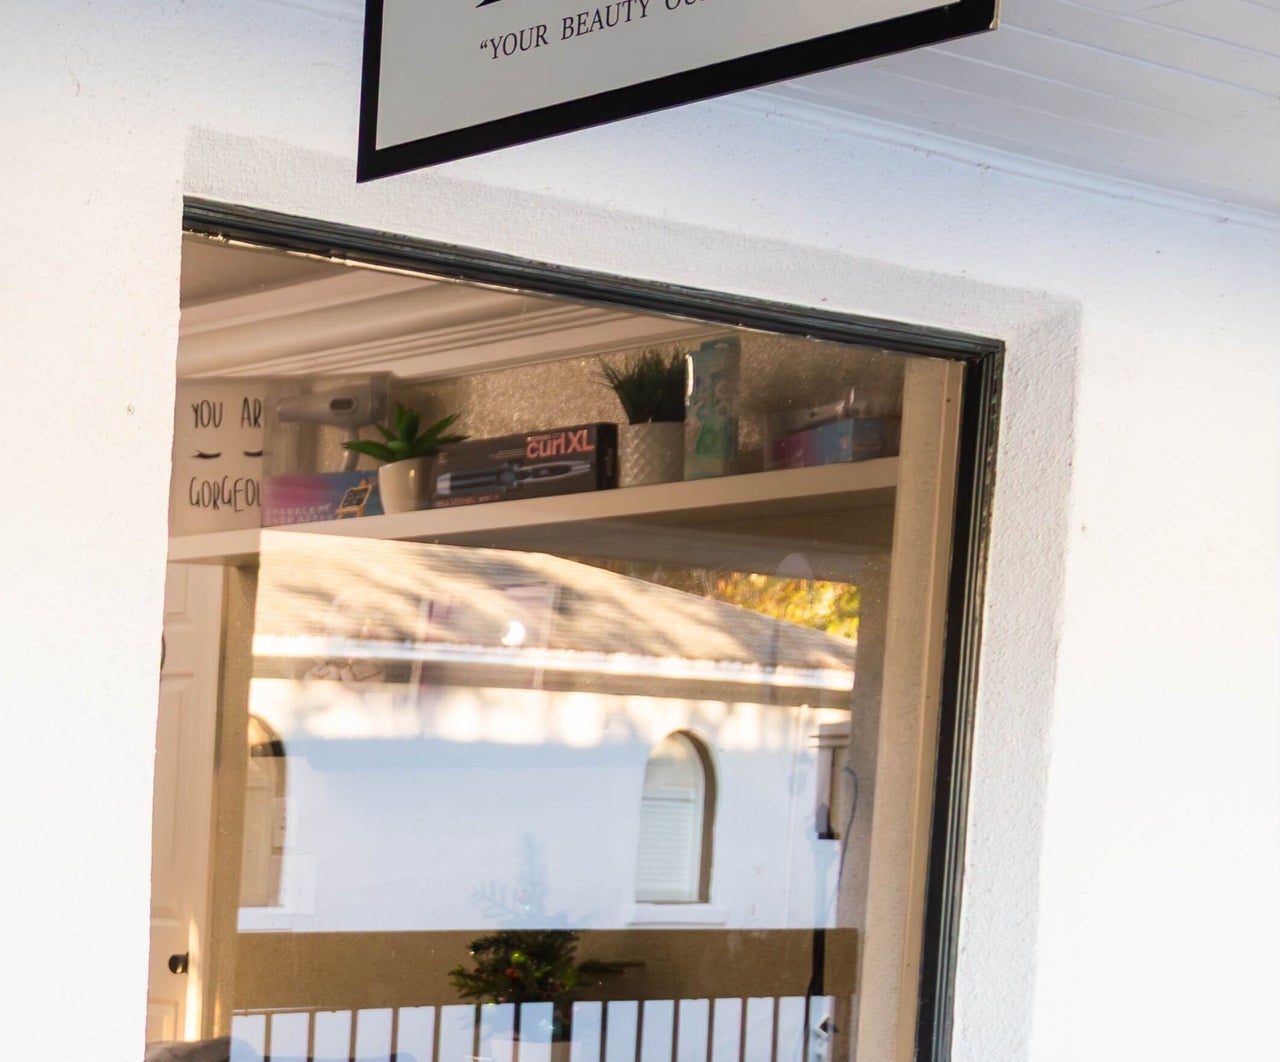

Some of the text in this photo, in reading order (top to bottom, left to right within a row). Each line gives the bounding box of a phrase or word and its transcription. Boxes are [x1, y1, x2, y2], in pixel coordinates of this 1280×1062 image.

[479, 0, 651, 60] “YOUR BEAUTY
[191, 399, 223, 428] YOU
